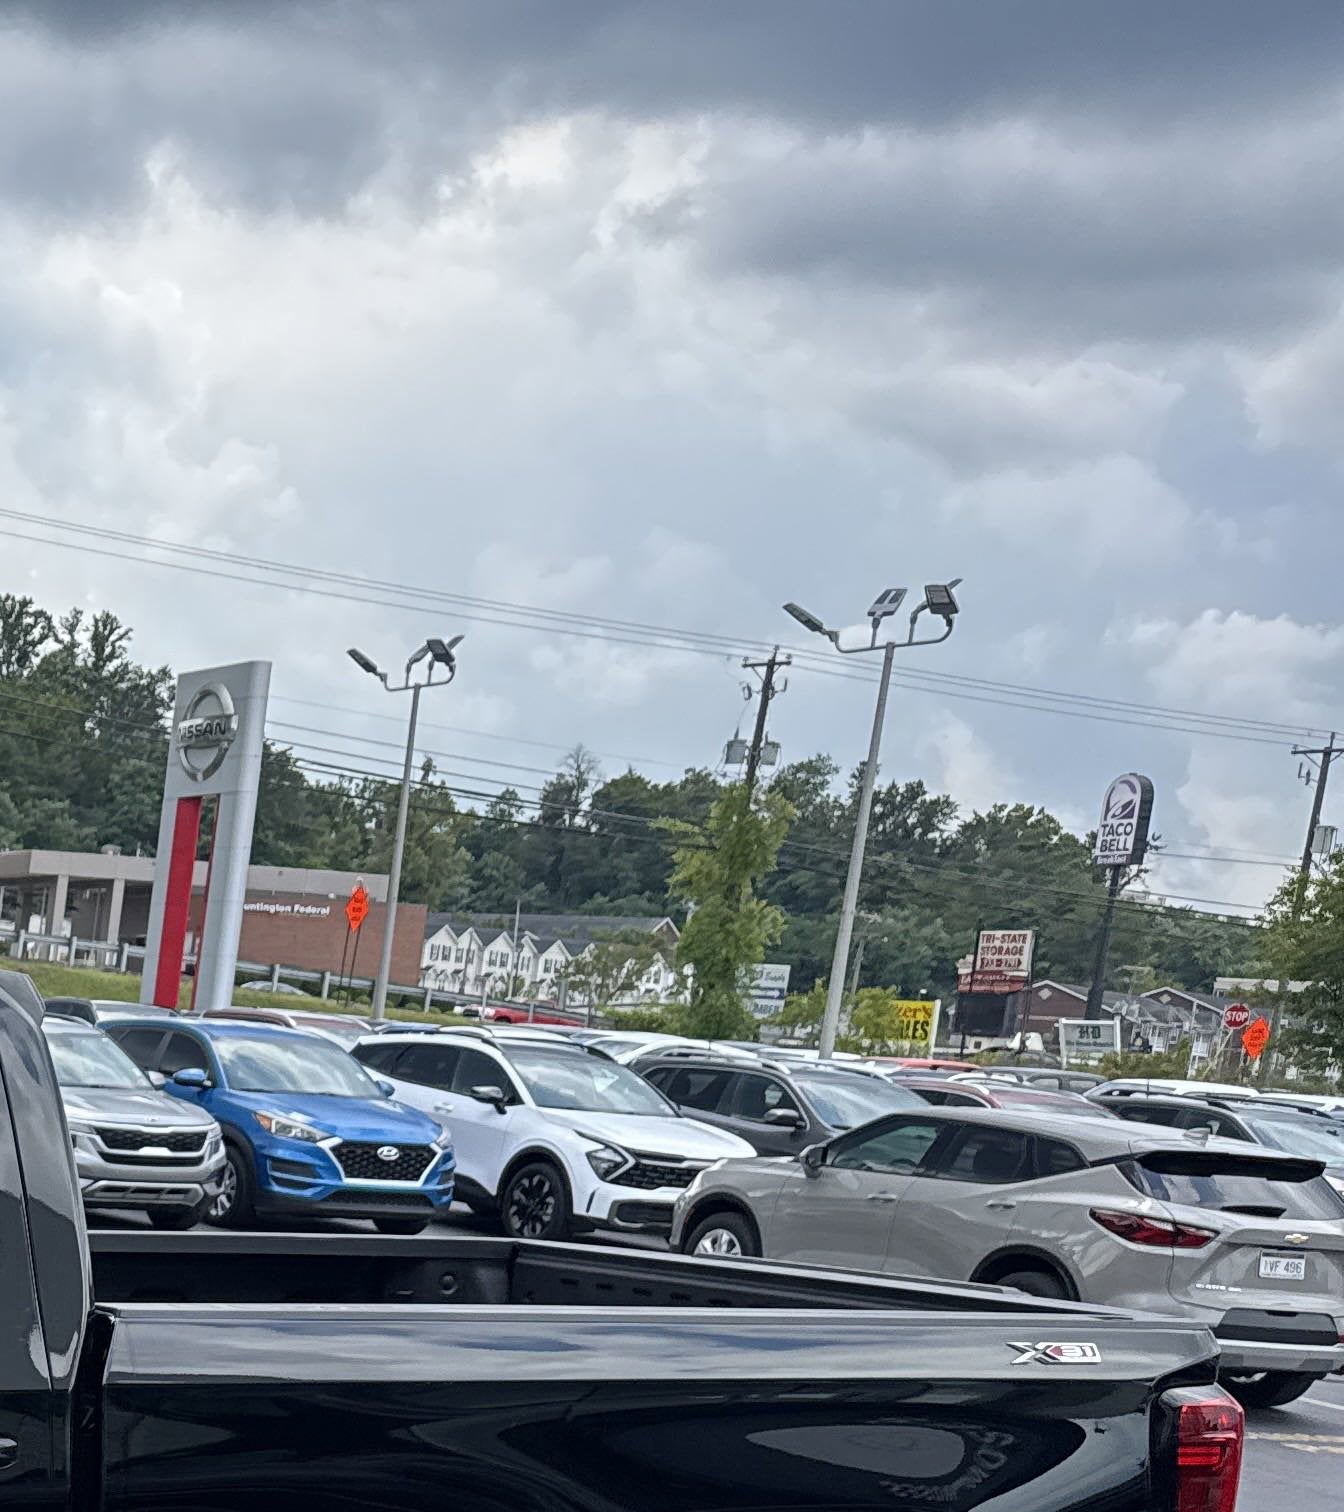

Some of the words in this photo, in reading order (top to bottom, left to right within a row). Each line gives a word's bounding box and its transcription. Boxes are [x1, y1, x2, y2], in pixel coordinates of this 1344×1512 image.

[1101, 822, 1134, 838] TACO
[1099, 838, 1130, 853] BELL
[293, 904, 330, 915] Federal
[981, 934, 1028, 945] TRI-STATE
[980, 945, 1025, 957] STORAGE
[1225, 1011, 1249, 1022] STOP
[1283, 1261, 1302, 1273] 496
[1005, 1341, 1102, 1365] X31
